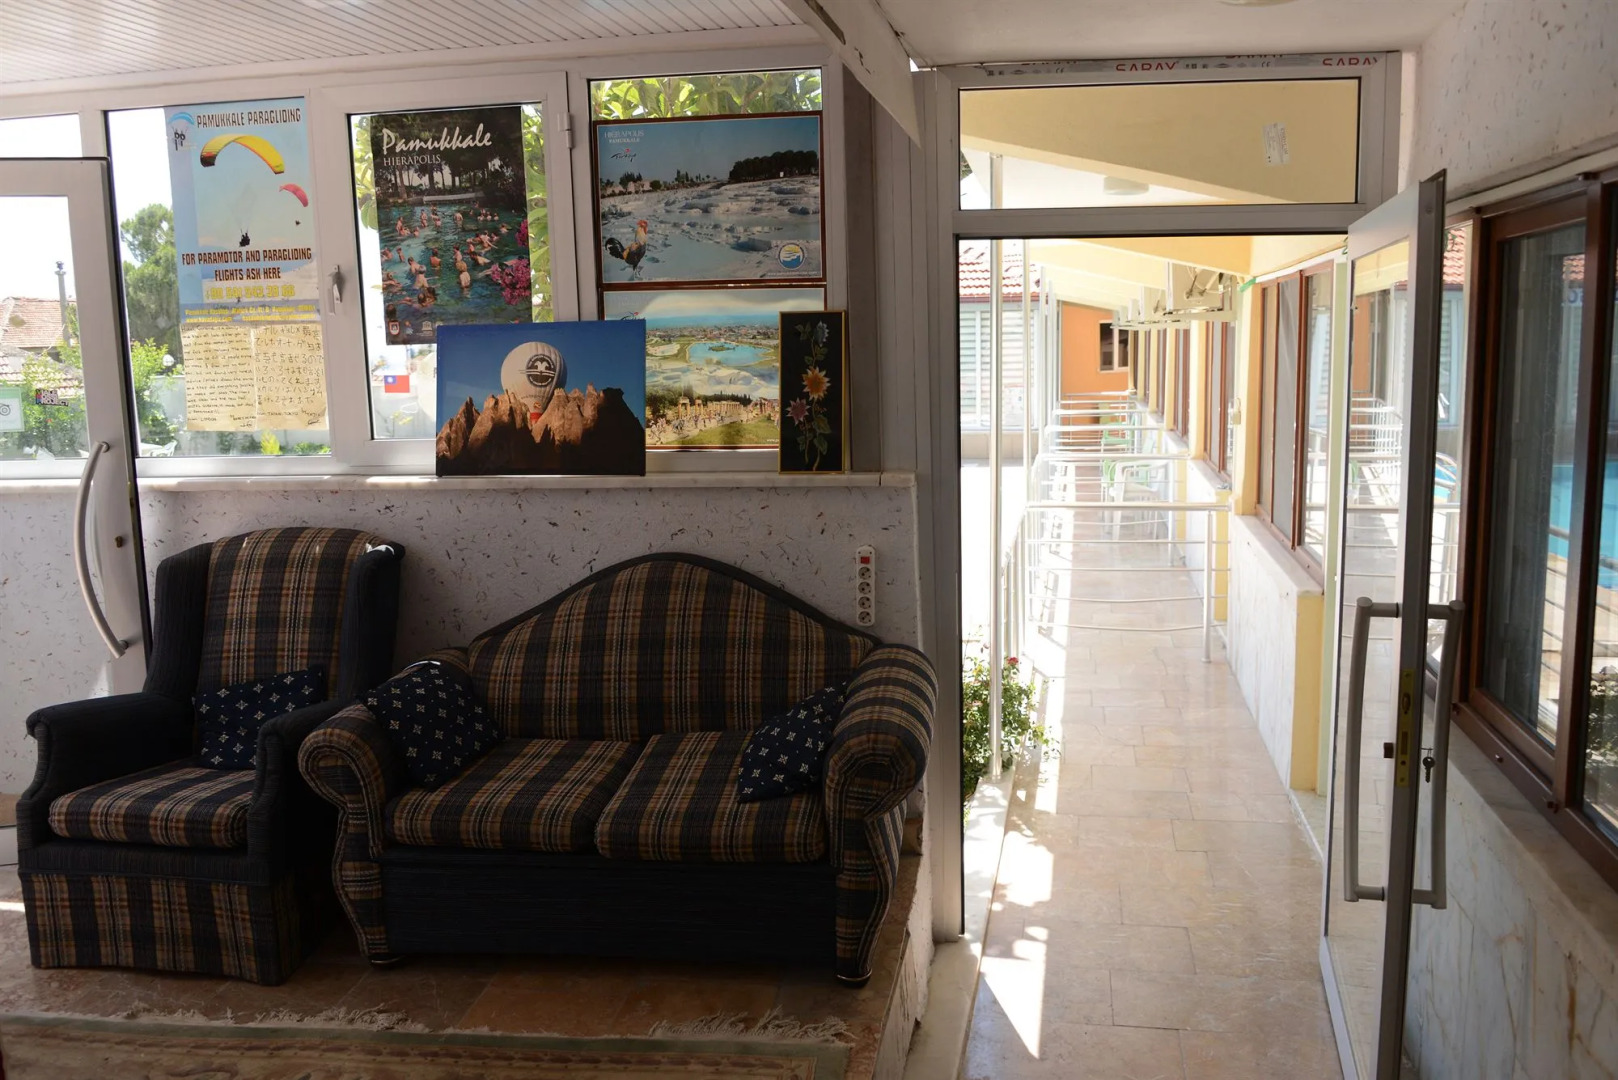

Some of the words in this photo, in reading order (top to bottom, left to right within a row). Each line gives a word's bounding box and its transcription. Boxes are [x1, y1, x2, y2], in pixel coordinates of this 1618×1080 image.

[197, 112, 245, 128] PAMUKKALE
[248, 108, 301, 124] PARAGLIDING
[382, 123, 492, 155] Pamukkale
[383, 154, 441, 166] HIERAPOLIS
[182, 253, 196, 265] FOR
[198, 250, 243, 264] PARAMOTOR
[245, 250, 260, 262] AND
[263, 248, 312, 261] PARAGLIDING
[214, 269, 244, 281] FLIGHTS
[246, 268, 260, 280] ASK
[263, 267, 281, 279] HERE
